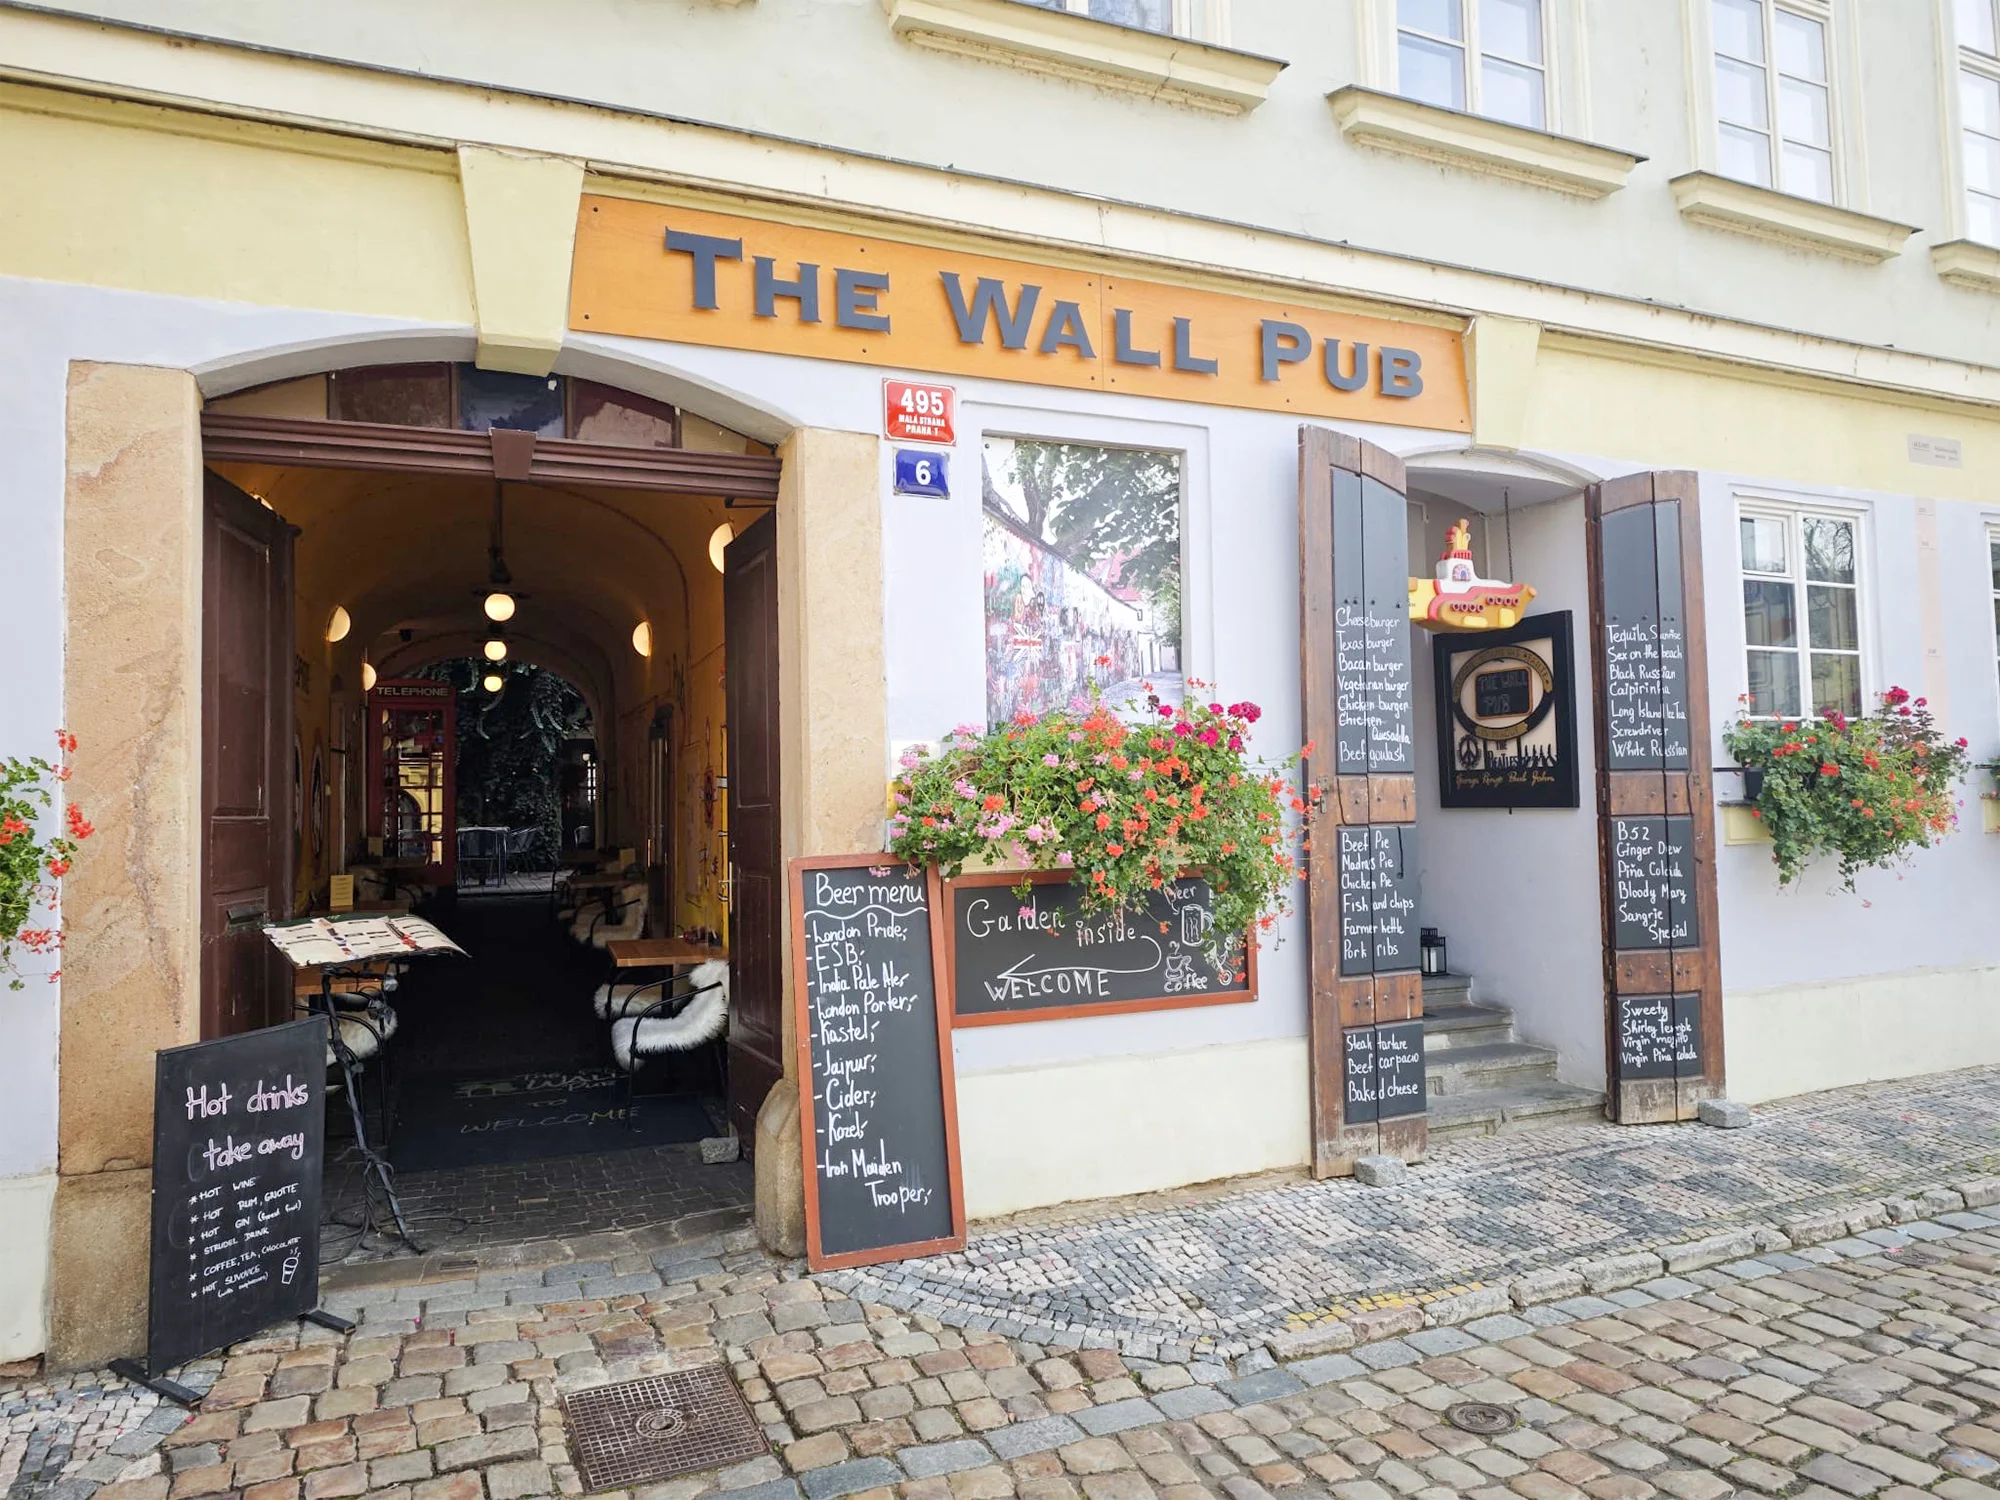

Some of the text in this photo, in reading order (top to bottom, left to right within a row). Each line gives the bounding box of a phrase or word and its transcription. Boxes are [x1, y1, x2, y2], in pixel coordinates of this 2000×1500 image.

[665, 226, 1425, 398] THE WALL PUB
[900, 388, 944, 416] 495
[898, 413, 946, 428] MALÁ STRANA
[905, 424, 939, 436] PRAHA 1
[915, 460, 931, 485] 6
[1336, 630, 1395, 653] Texas burger
[1606, 623, 1648, 649] Tequila
[1607, 643, 1683, 663] Sex on the beach
[1372, 654, 1404, 678] burger
[1609, 663, 1676, 680] Black Russian
[377, 686, 449, 696] TELEPHONE
[1384, 677, 1409, 698] burger
[1609, 679, 1671, 702] Caipirinha
[1338, 693, 1409, 719] Chicken burger
[1611, 699, 1634, 723] Long
[1638, 698, 1665, 719] Island
[1339, 711, 1382, 727] Chicken
[1610, 719, 1669, 738] Screwdriver
[1340, 739, 1405, 769] Beef goulash
[1611, 738, 1688, 757] White Russian
[1342, 830, 1390, 853] Beef Pie
[1617, 820, 1650, 841] B52
[1379, 851, 1394, 868] Pie
[1616, 842, 1653, 861] Ginger
[815, 872, 925, 906] Beer menu
[1341, 871, 1393, 890] Chicken Pie
[1618, 879, 1687, 905] Bloody Mary
[1163, 886, 1197, 905] Beer
[1343, 890, 1415, 917] Fish and chips
[967, 895, 1137, 947] Garden inside
[1343, 917, 1378, 937] Farmer
[1648, 919, 1687, 944] Special
[1344, 936, 1399, 961] Pork ribs
[819, 968, 850, 994] India
[852, 964, 880, 990] Pale
[984, 970, 1112, 1001] WELCOME
[1622, 1000, 1668, 1021] Sweety
[1622, 1018, 1658, 1038] Shirley
[1346, 1031, 1408, 1051] Steak tartare
[1622, 1035, 1650, 1051] Virgin
[1347, 1052, 1420, 1075] Beef carpacio
[1622, 1051, 1649, 1068] Virgin
[185, 1073, 309, 1120] Hot drinks
[1348, 1074, 1418, 1102] Baked cheese
[203, 1132, 305, 1171] take away
[851, 1138, 902, 1178] Maiden
[199, 1176, 259, 1200] HOT WINE
[203, 1206, 224, 1221] HOT
[201, 1226, 220, 1240] HOT
[234, 1215, 251, 1229] GIN
[203, 1226, 270, 1255] STRUDEL DRINK
[261, 1236, 302, 1254] CHOCOLATE
[202, 1280, 218, 1295] HOT
